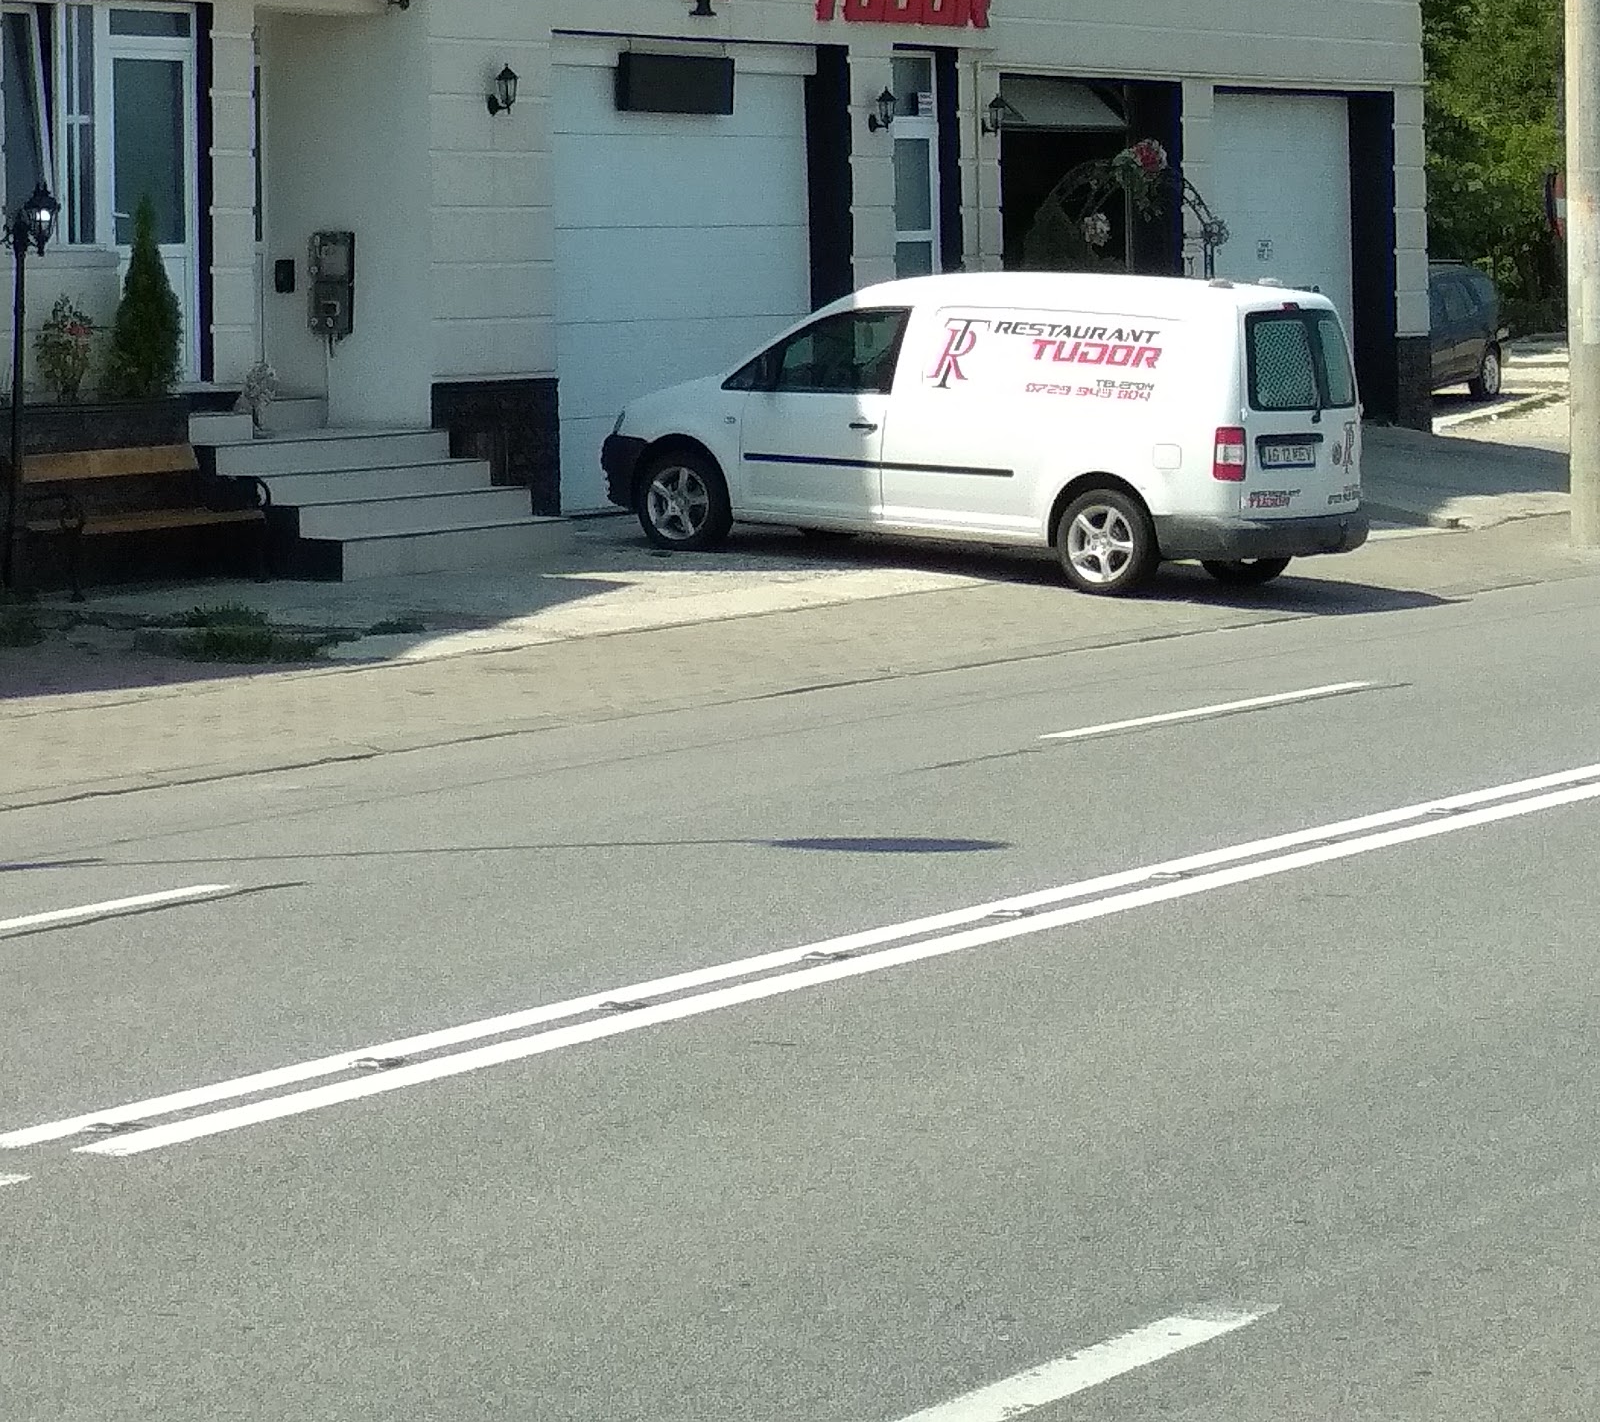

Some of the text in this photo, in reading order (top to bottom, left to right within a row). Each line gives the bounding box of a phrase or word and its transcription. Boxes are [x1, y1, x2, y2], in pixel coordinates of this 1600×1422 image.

[994, 320, 1161, 344] RESTAURANT
[1032, 338, 1162, 369] TUDOR
[1025, 382, 1072, 397] 0729
